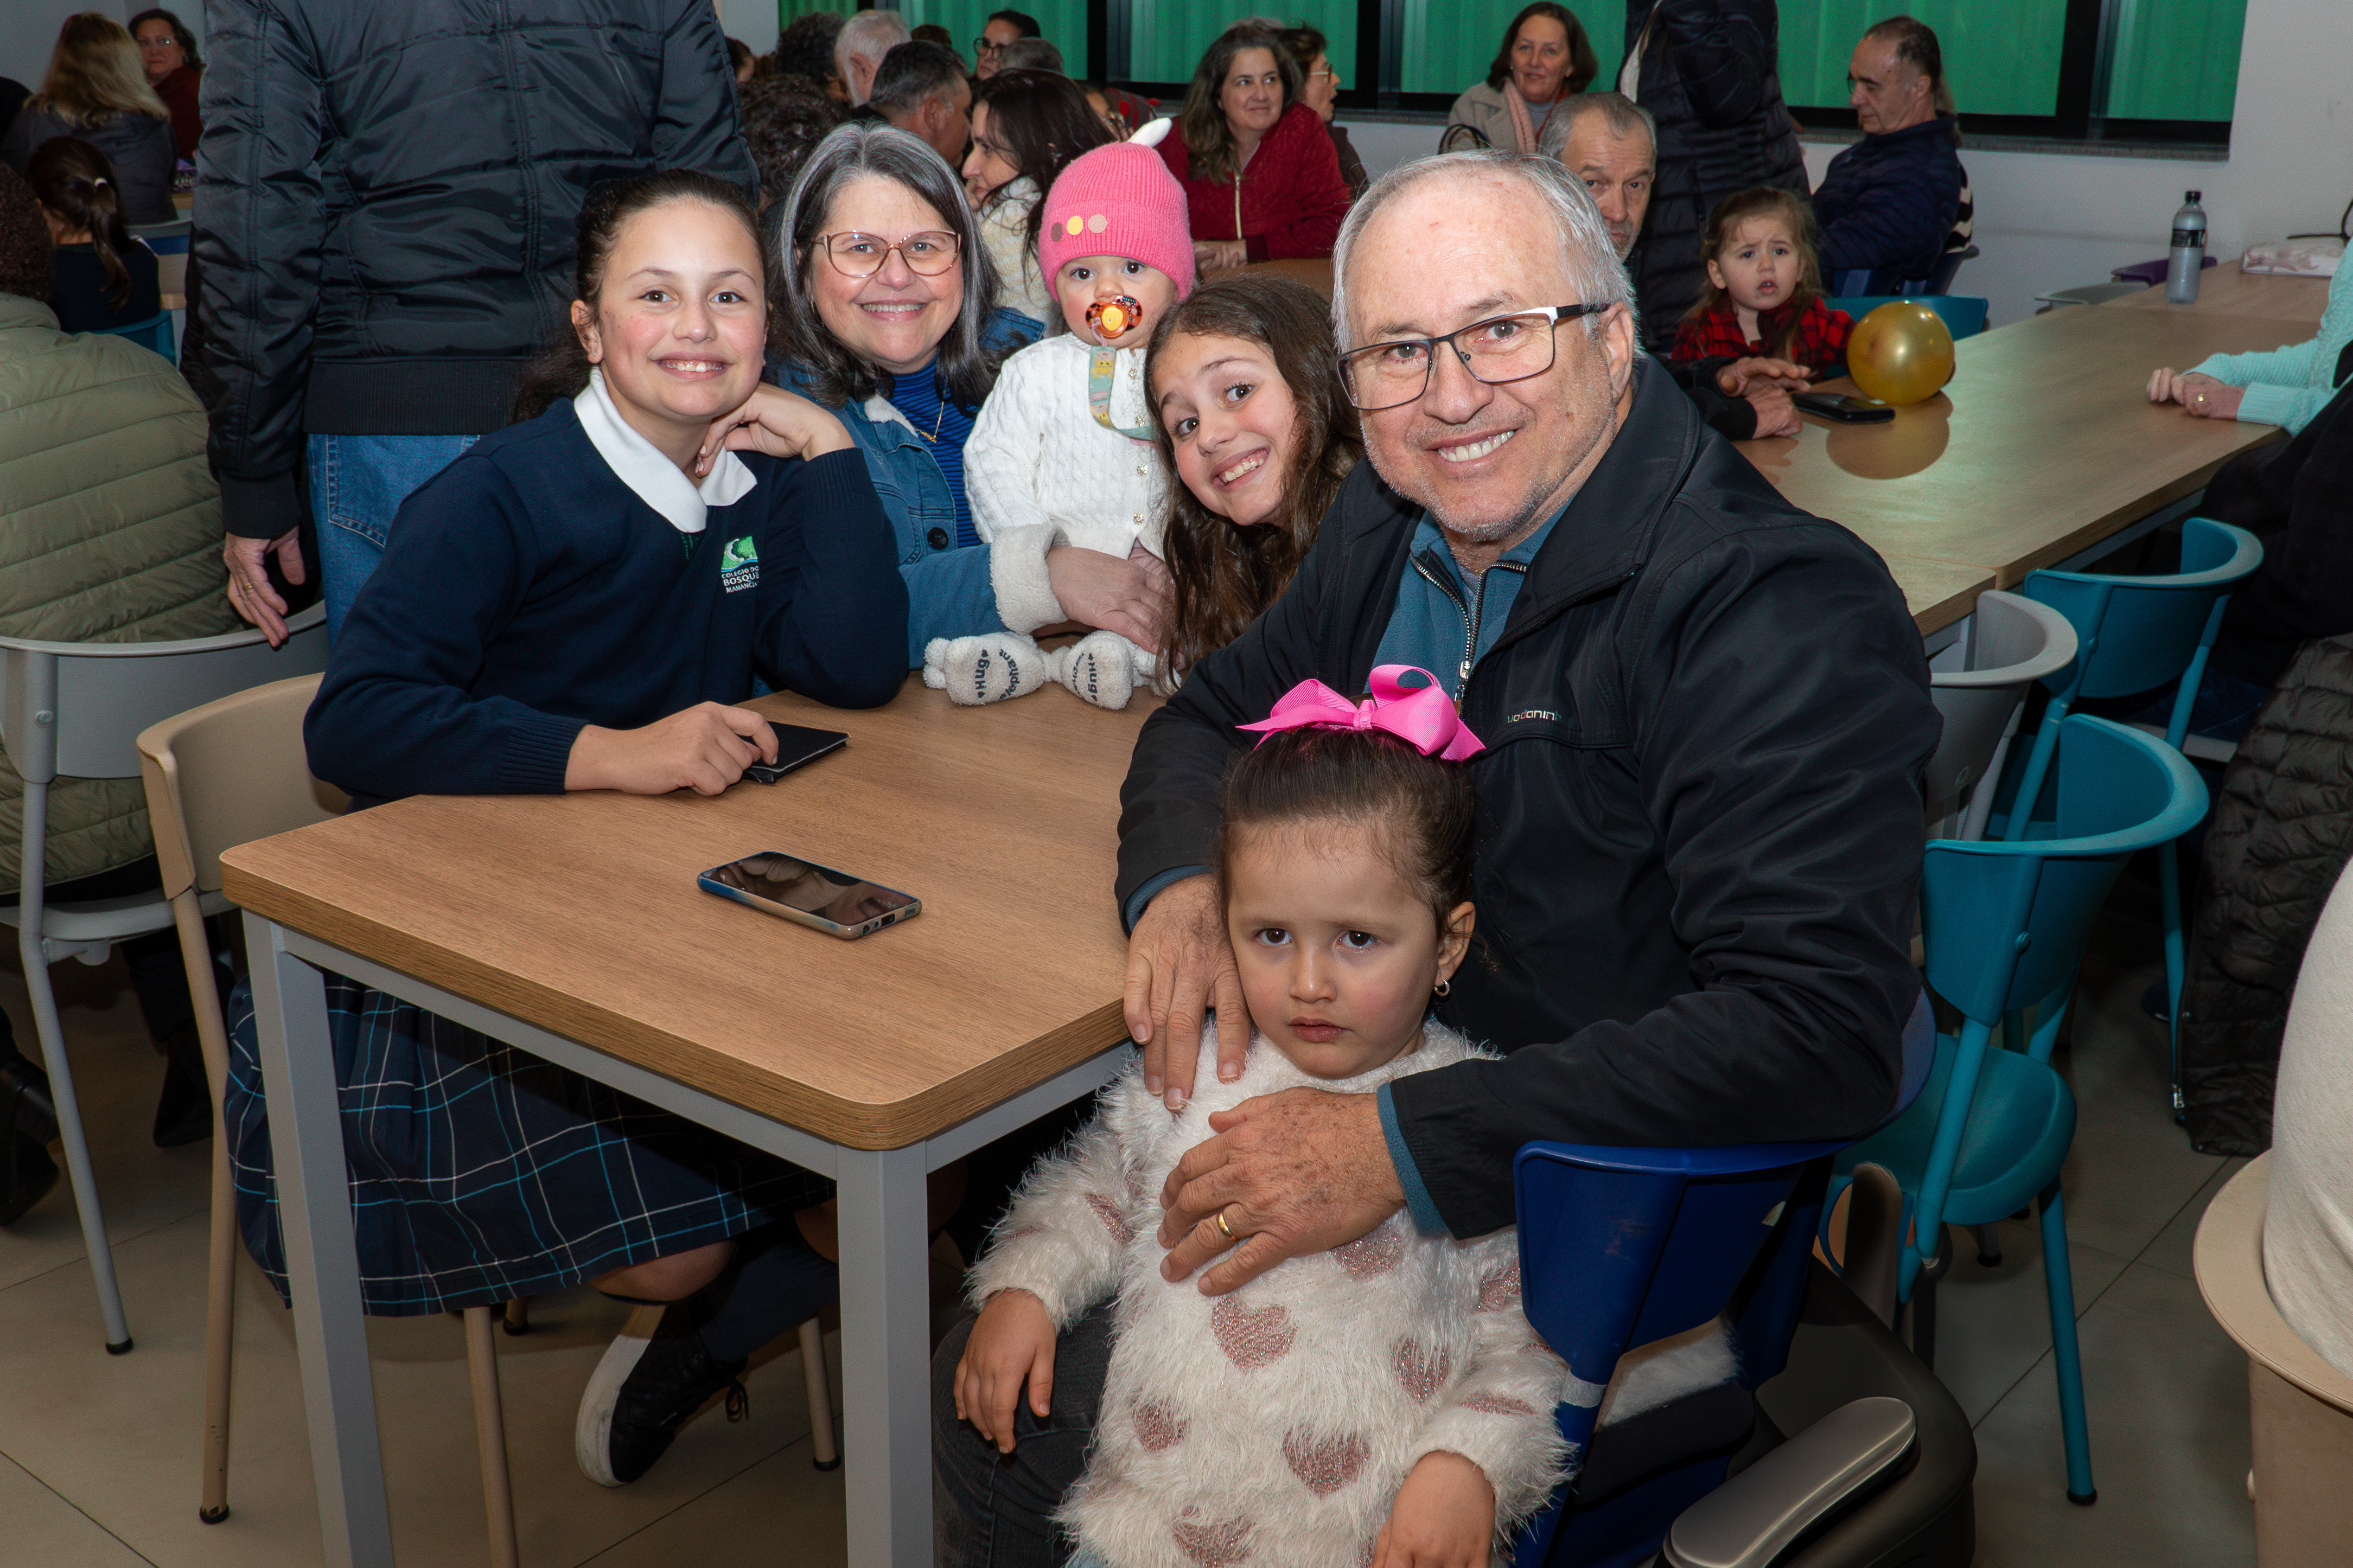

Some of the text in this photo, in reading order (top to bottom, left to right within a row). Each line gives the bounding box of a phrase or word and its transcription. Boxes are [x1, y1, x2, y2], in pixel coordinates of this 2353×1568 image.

[723, 572, 759, 586] BOSQUE
[975, 659, 990, 690] Hug
[1088, 662, 1098, 694] Hug
